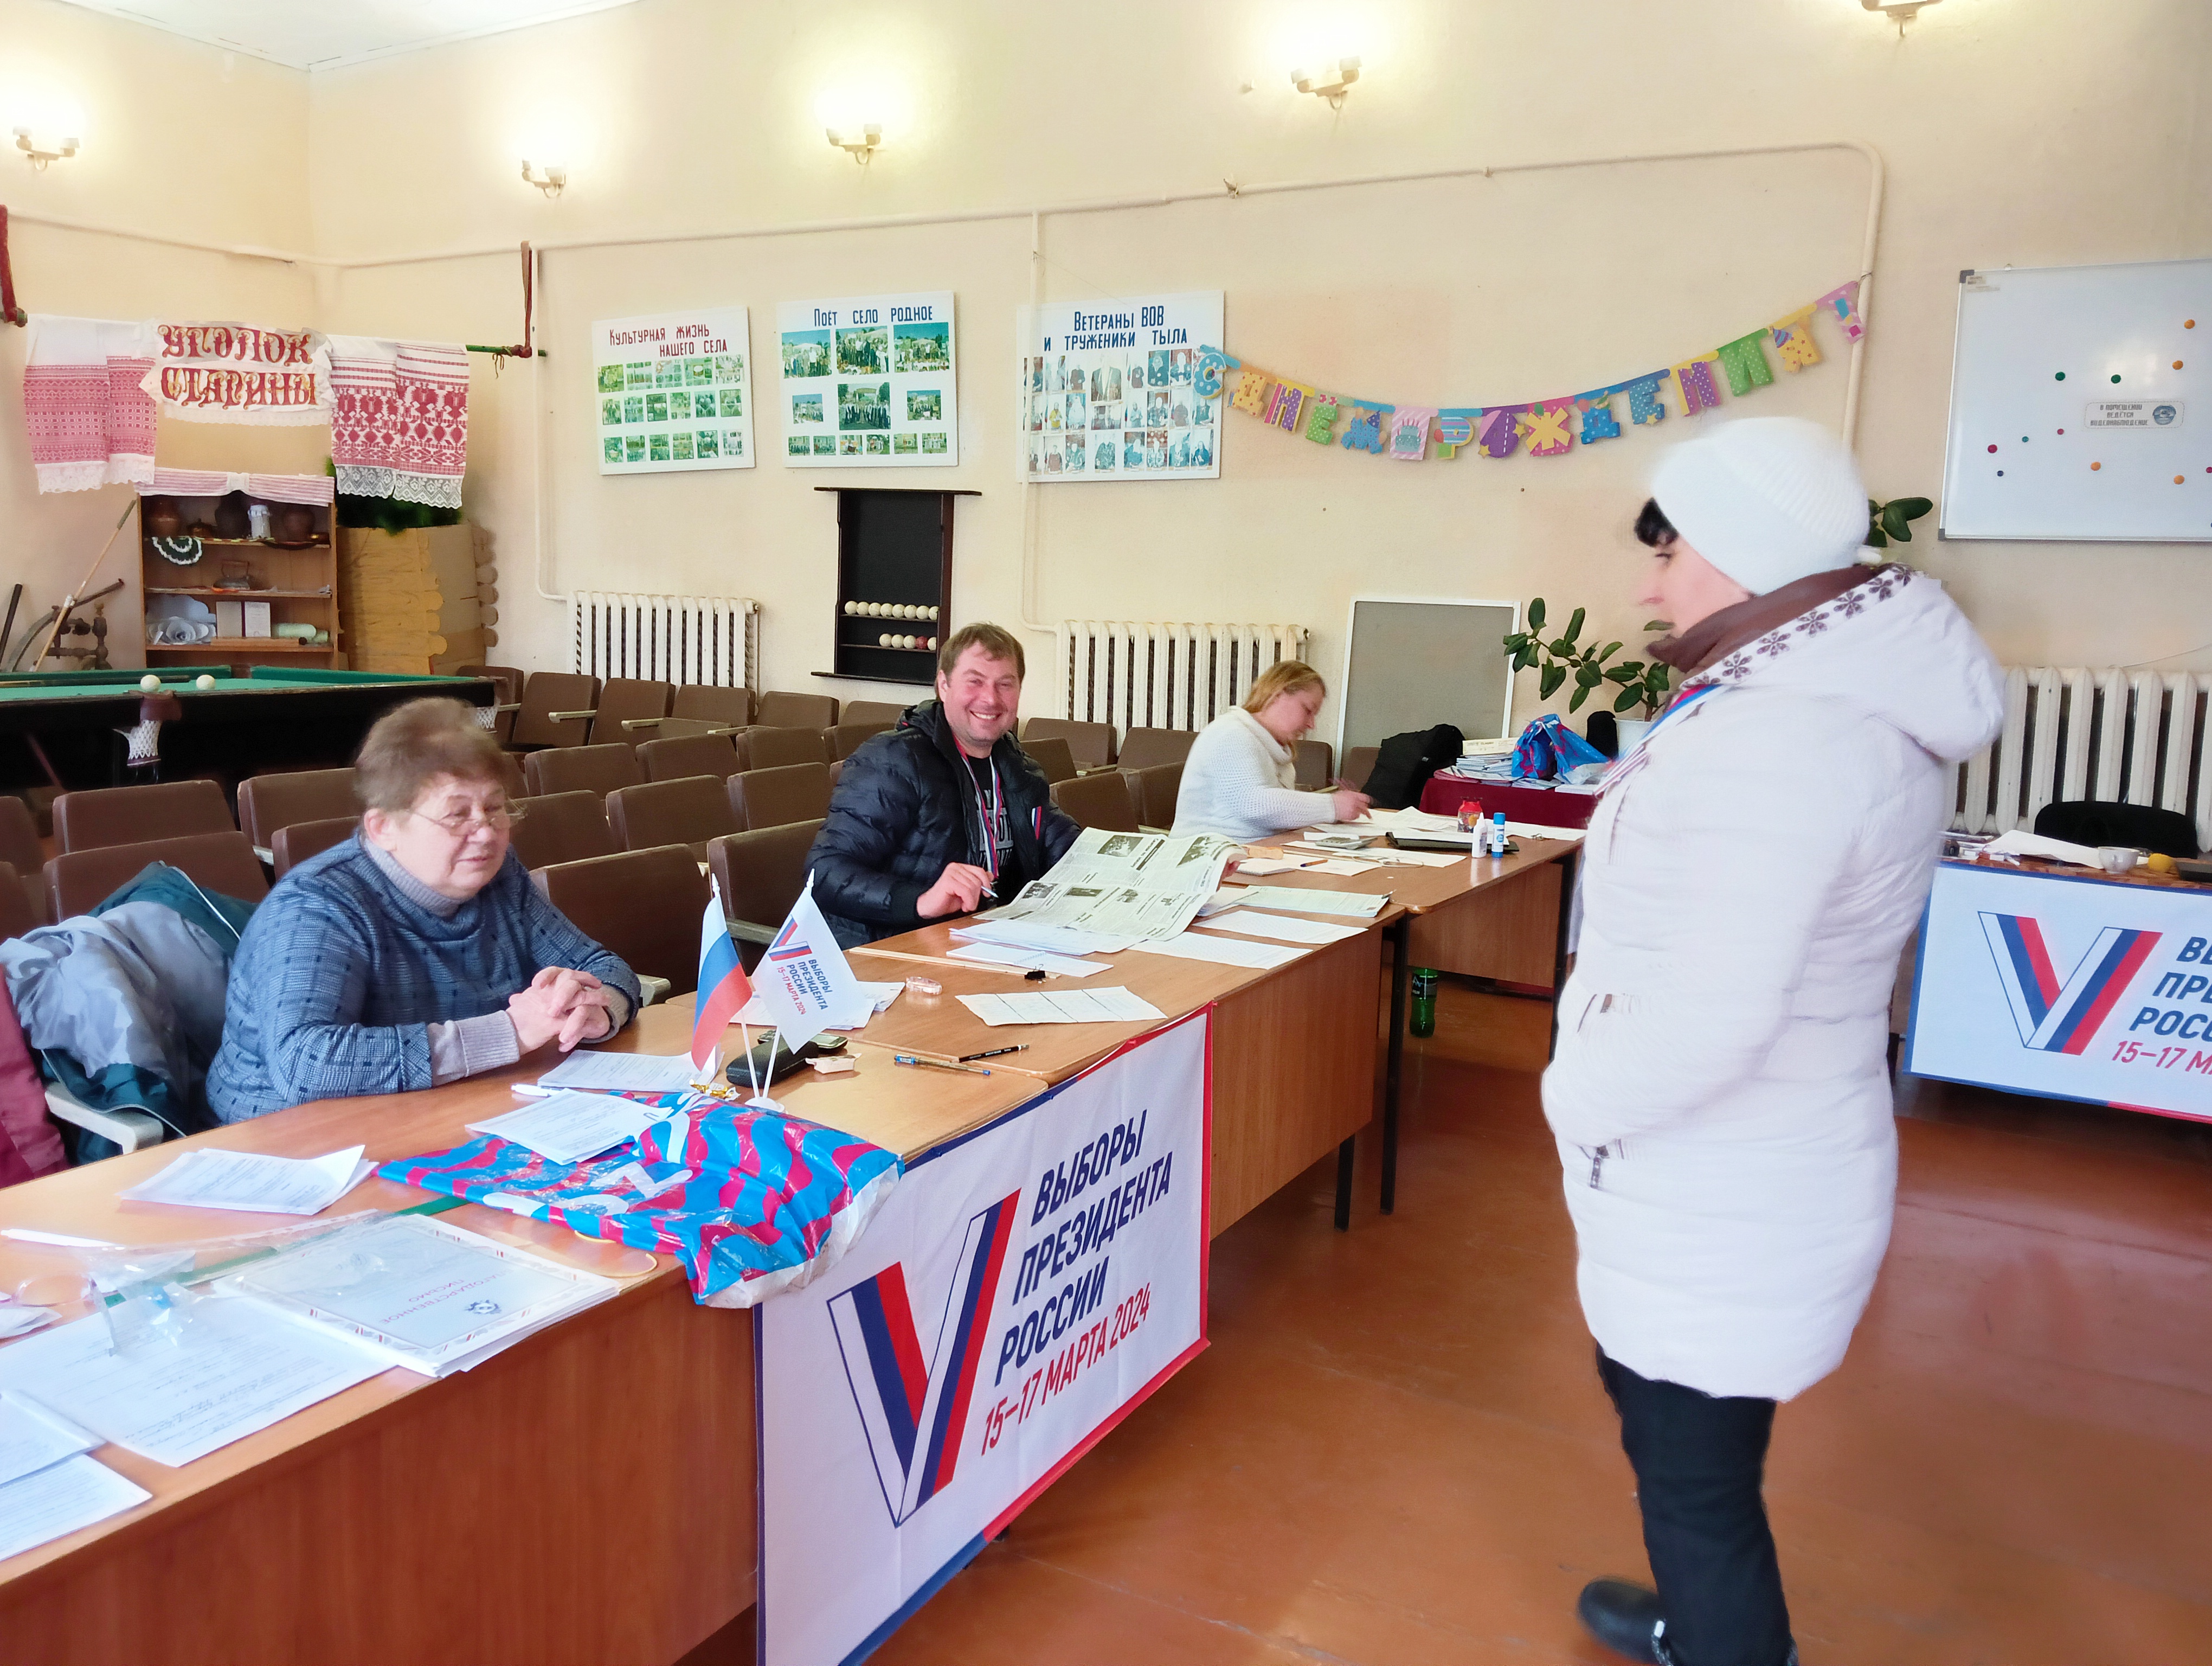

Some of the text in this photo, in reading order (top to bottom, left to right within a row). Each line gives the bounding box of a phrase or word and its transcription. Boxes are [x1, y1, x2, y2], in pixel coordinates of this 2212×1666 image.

[853, 309, 878, 324] СЕЛО
[891, 306, 933, 322] РОДНОЕ
[1074, 305, 1164, 331] ВЕТЕРАНЫ ВОВ
[158, 324, 313, 367] УГОЛОК
[610, 324, 709, 346] КУЛЬТУРНАЯ ЖИЗНЬ
[660, 339, 728, 357] НАШЕГО СЕЛА
[1044, 328, 1187, 351] И ТРУЖЕНИКИ ТЫЛА
[161, 367, 319, 409] СТАРИНЫ
[787, 964, 808, 995] РОССИИ
[798, 962, 828, 1010] ПРЕЗИДЕНТА
[808, 959, 833, 992] ВЫБОРЫ
[785, 982, 800, 1001] МАРТА
[795, 1002, 807, 1015] 2024
[2185, 1051, 2212, 1075] М
[1031, 1108, 1147, 1227] ВЫБОРЫ
[1012, 1151, 1173, 1306] ПРЕЗИДЕНТА
[409, 1279, 465, 1303] ПИСЬМО
[994, 1255, 1110, 1388] РОССИИ
[1041, 1316, 1108, 1406] МАРТА
[1109, 1282, 1150, 1350] 2024
